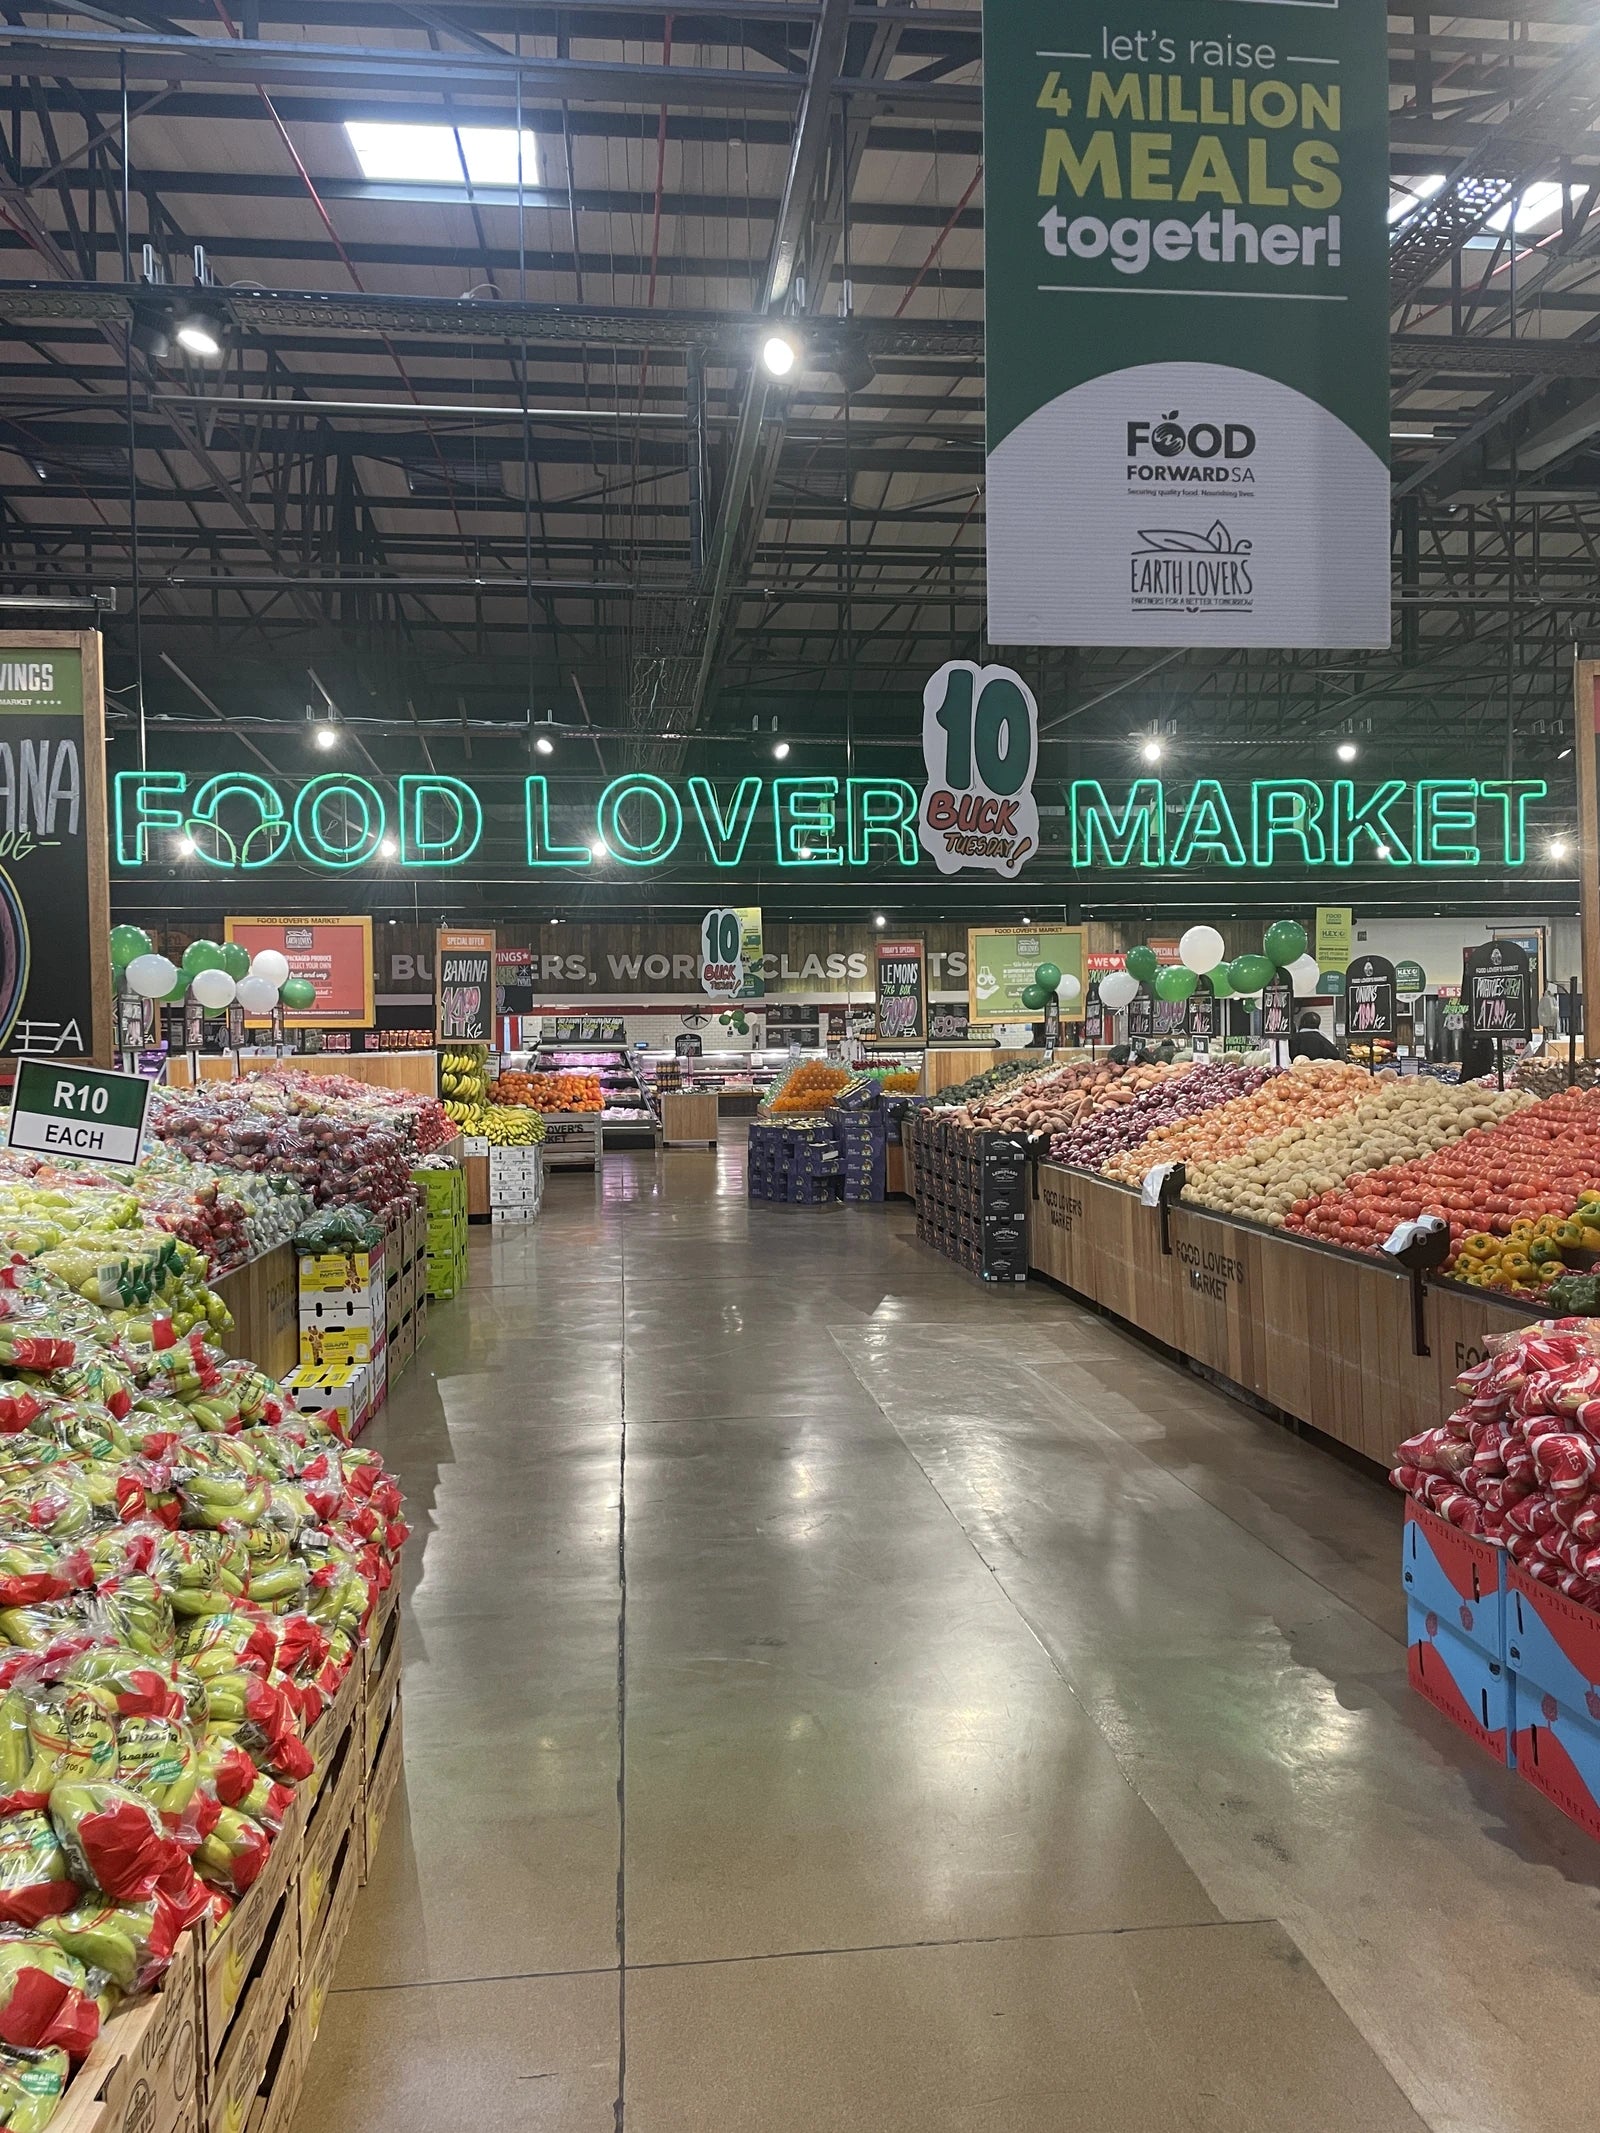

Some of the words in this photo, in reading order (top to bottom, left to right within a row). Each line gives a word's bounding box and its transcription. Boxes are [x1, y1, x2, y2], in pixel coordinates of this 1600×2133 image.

[1102, 27, 1176, 63] let's
[1190, 36, 1277, 69] raise
[1036, 72, 1073, 118] 4
[1087, 72, 1341, 131] MILLION
[1037, 129, 1343, 209] MEALS
[1037, 206, 1342, 275] together!
[1127, 421, 1256, 459] FOOD
[1131, 559, 1182, 595] EARTH
[1188, 560, 1253, 596] LOVERS
[935, 668, 1031, 796] 10
[115, 771, 483, 868] FOOD
[1071, 778, 1547, 867] MARKET
[926, 790, 1019, 835] BUCK
[706, 913, 740, 964] 10
[443, 960, 488, 983] BANANA
[703, 964, 736, 981] BUCK
[762, 953, 868, 979] CLASS
[881, 963, 918, 984] LEMONS
[1094, 957, 1109, 967] WE
[10, 1018, 84, 1053] EA
[467, 1023, 483, 1039] KG
[53, 1080, 109, 1114] R10
[45, 1124, 104, 1150] EACH
[1043, 1188, 1058, 1210] FOOD
[1058, 1193, 1082, 1218] LOVER'S
[1050, 1209, 1073, 1232] MARKET
[1176, 1240, 1200, 1266] FOOD
[1202, 1252, 1244, 1284] LOVER'S
[1189, 1269, 1228, 1300] MARKET
[1557, 1438, 1582, 1472] APPLES
